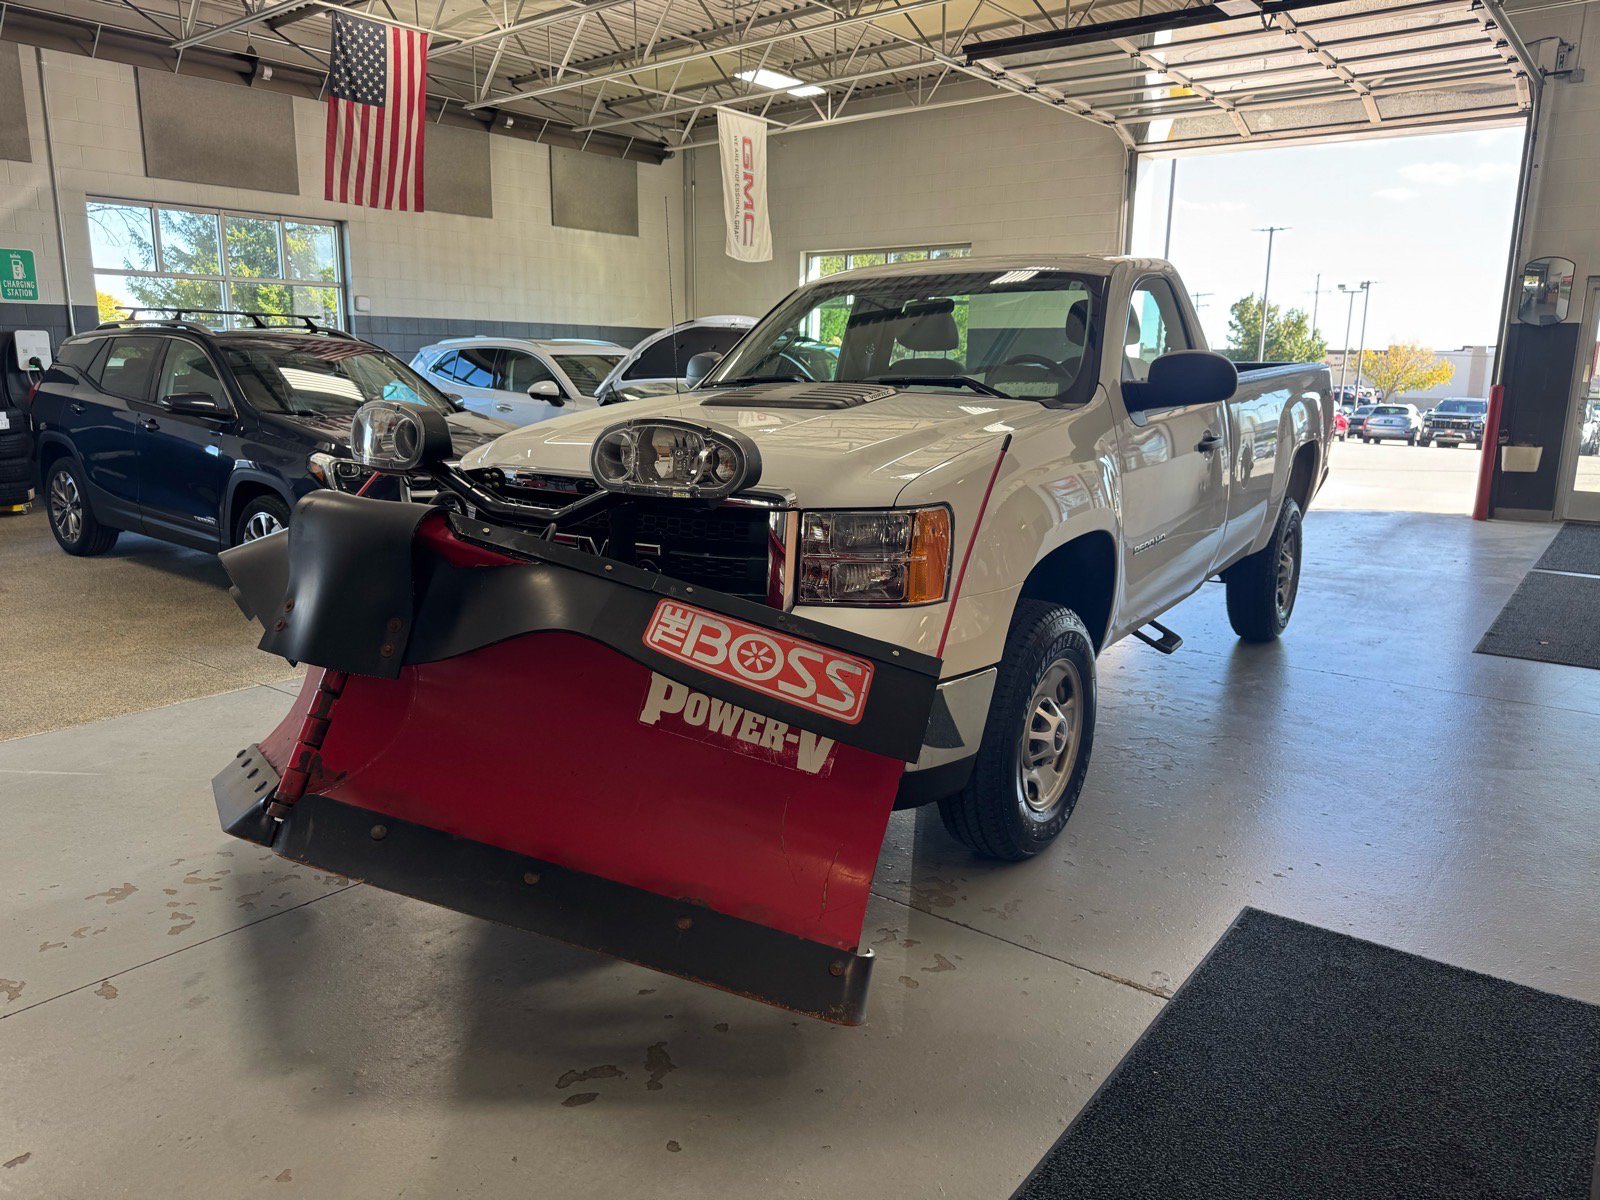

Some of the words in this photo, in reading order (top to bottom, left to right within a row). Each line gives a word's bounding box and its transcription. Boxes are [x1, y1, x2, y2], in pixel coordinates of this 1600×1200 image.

[742, 136, 754, 246] GMC
[3, 280, 35, 289] CHARGING
[7, 289, 33, 297] STATION
[652, 605, 693, 648] THE
[681, 614, 862, 711] BOSS
